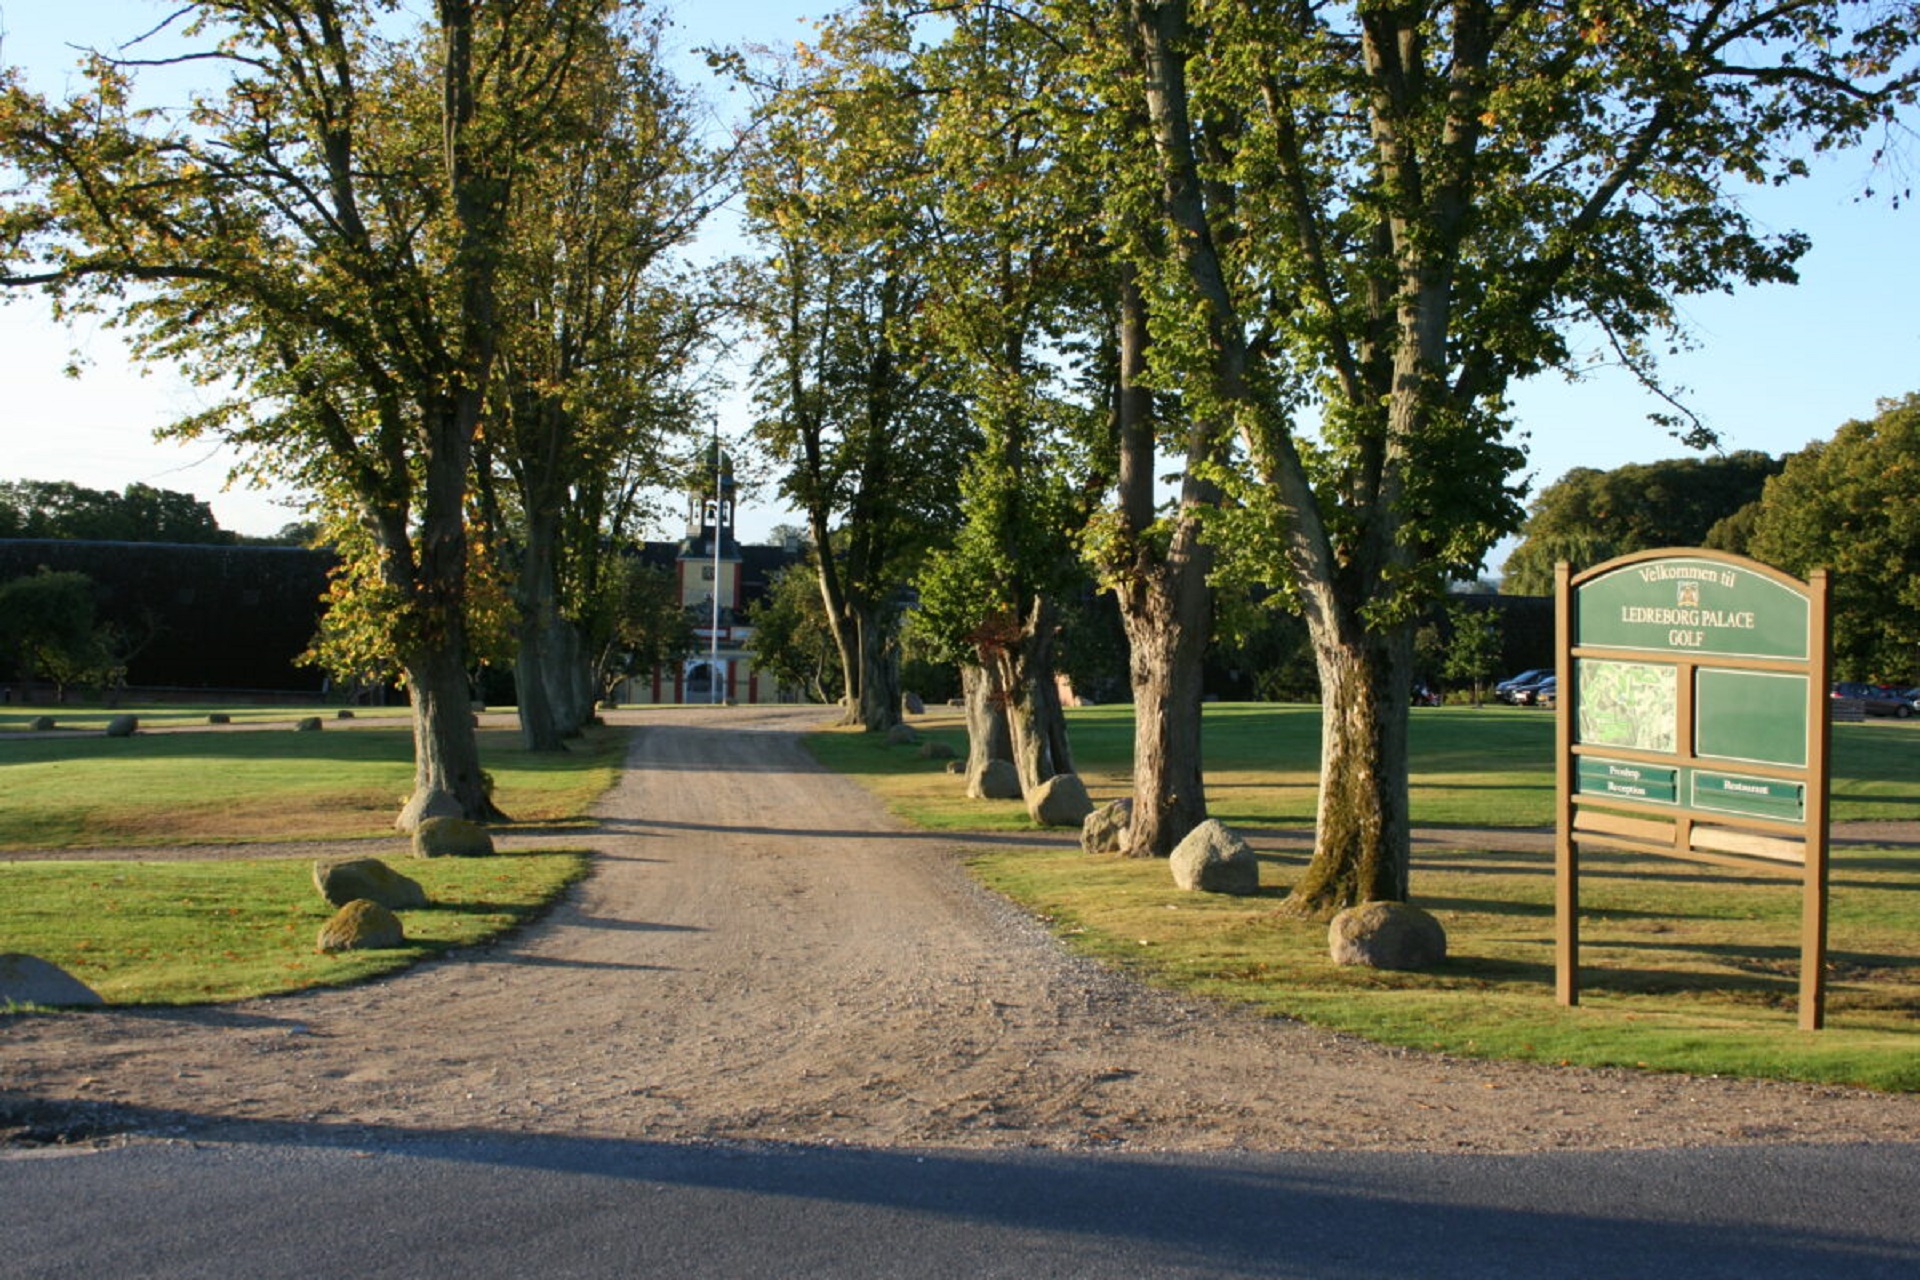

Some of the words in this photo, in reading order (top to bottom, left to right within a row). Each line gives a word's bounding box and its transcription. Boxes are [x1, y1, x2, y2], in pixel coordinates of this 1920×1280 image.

[1639, 565, 1717, 583] Velkommen
[1720, 571, 1736, 588] til
[1621, 605, 1699, 625] LEDREBORG
[1701, 611, 1755, 628] PALACE
[1669, 630, 1704, 647] GOLF
